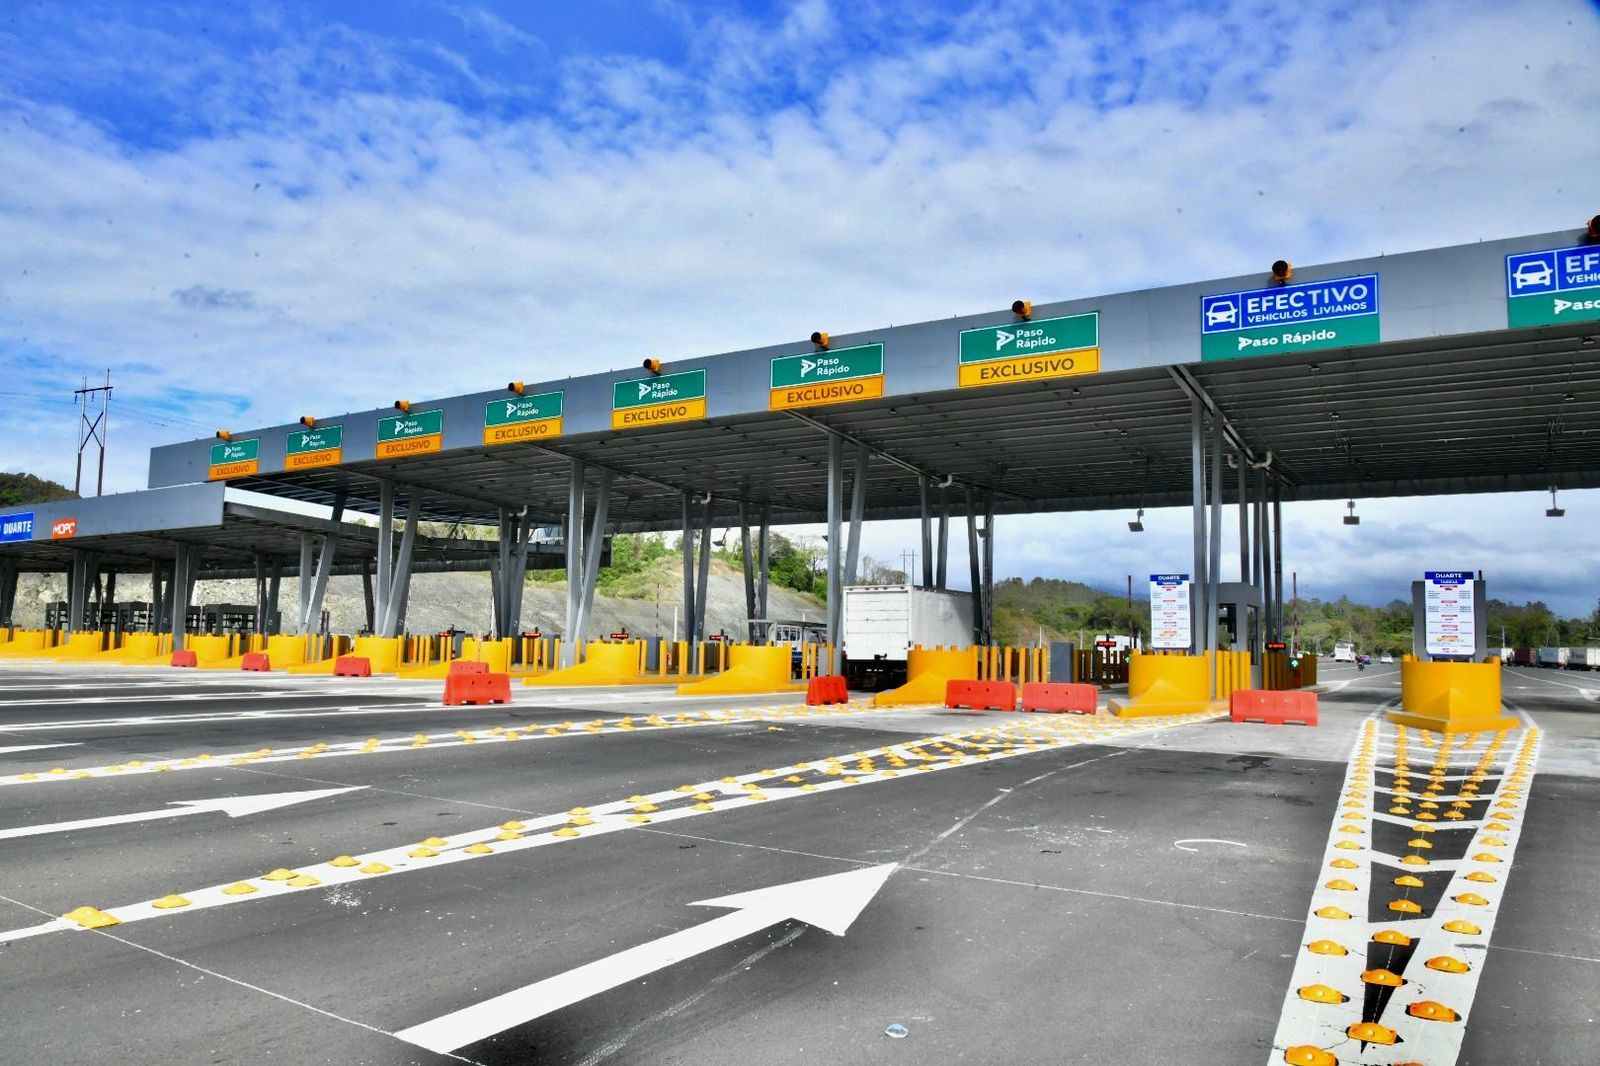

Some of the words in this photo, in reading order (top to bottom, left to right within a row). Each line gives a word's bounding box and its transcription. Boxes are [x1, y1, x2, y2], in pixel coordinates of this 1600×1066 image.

[1247, 284, 1368, 314] EFECTIVO
[1247, 310, 1308, 323] VEHICULOS
[1314, 302, 1367, 316] LIVIANOS
[1016, 328, 1044, 338] Paso
[1016, 336, 1056, 349] Rápido
[1238, 336, 1279, 351] Paso
[1282, 329, 1336, 345] Rápido
[817, 357, 840, 367] Paso
[816, 364, 850, 377] Rápido
[980, 358, 1074, 380] EXCLUSIVO
[652, 381, 671, 390] Paso
[651, 388, 678, 399] Rápido
[787, 383, 864, 403] EXCLUSIVO
[517, 401, 533, 409] Paso
[516, 408, 539, 417] Rápido
[623, 406, 687, 423] EXCLUSIVO
[495, 424, 548, 440] EXCLUSIVO
[386, 439, 430, 453] EXCLUSIVO
[293, 454, 332, 466] EXCLUSIVO
[216, 465, 250, 475] EXCLUSIVO
[3, 520, 32, 535] DUARTE
